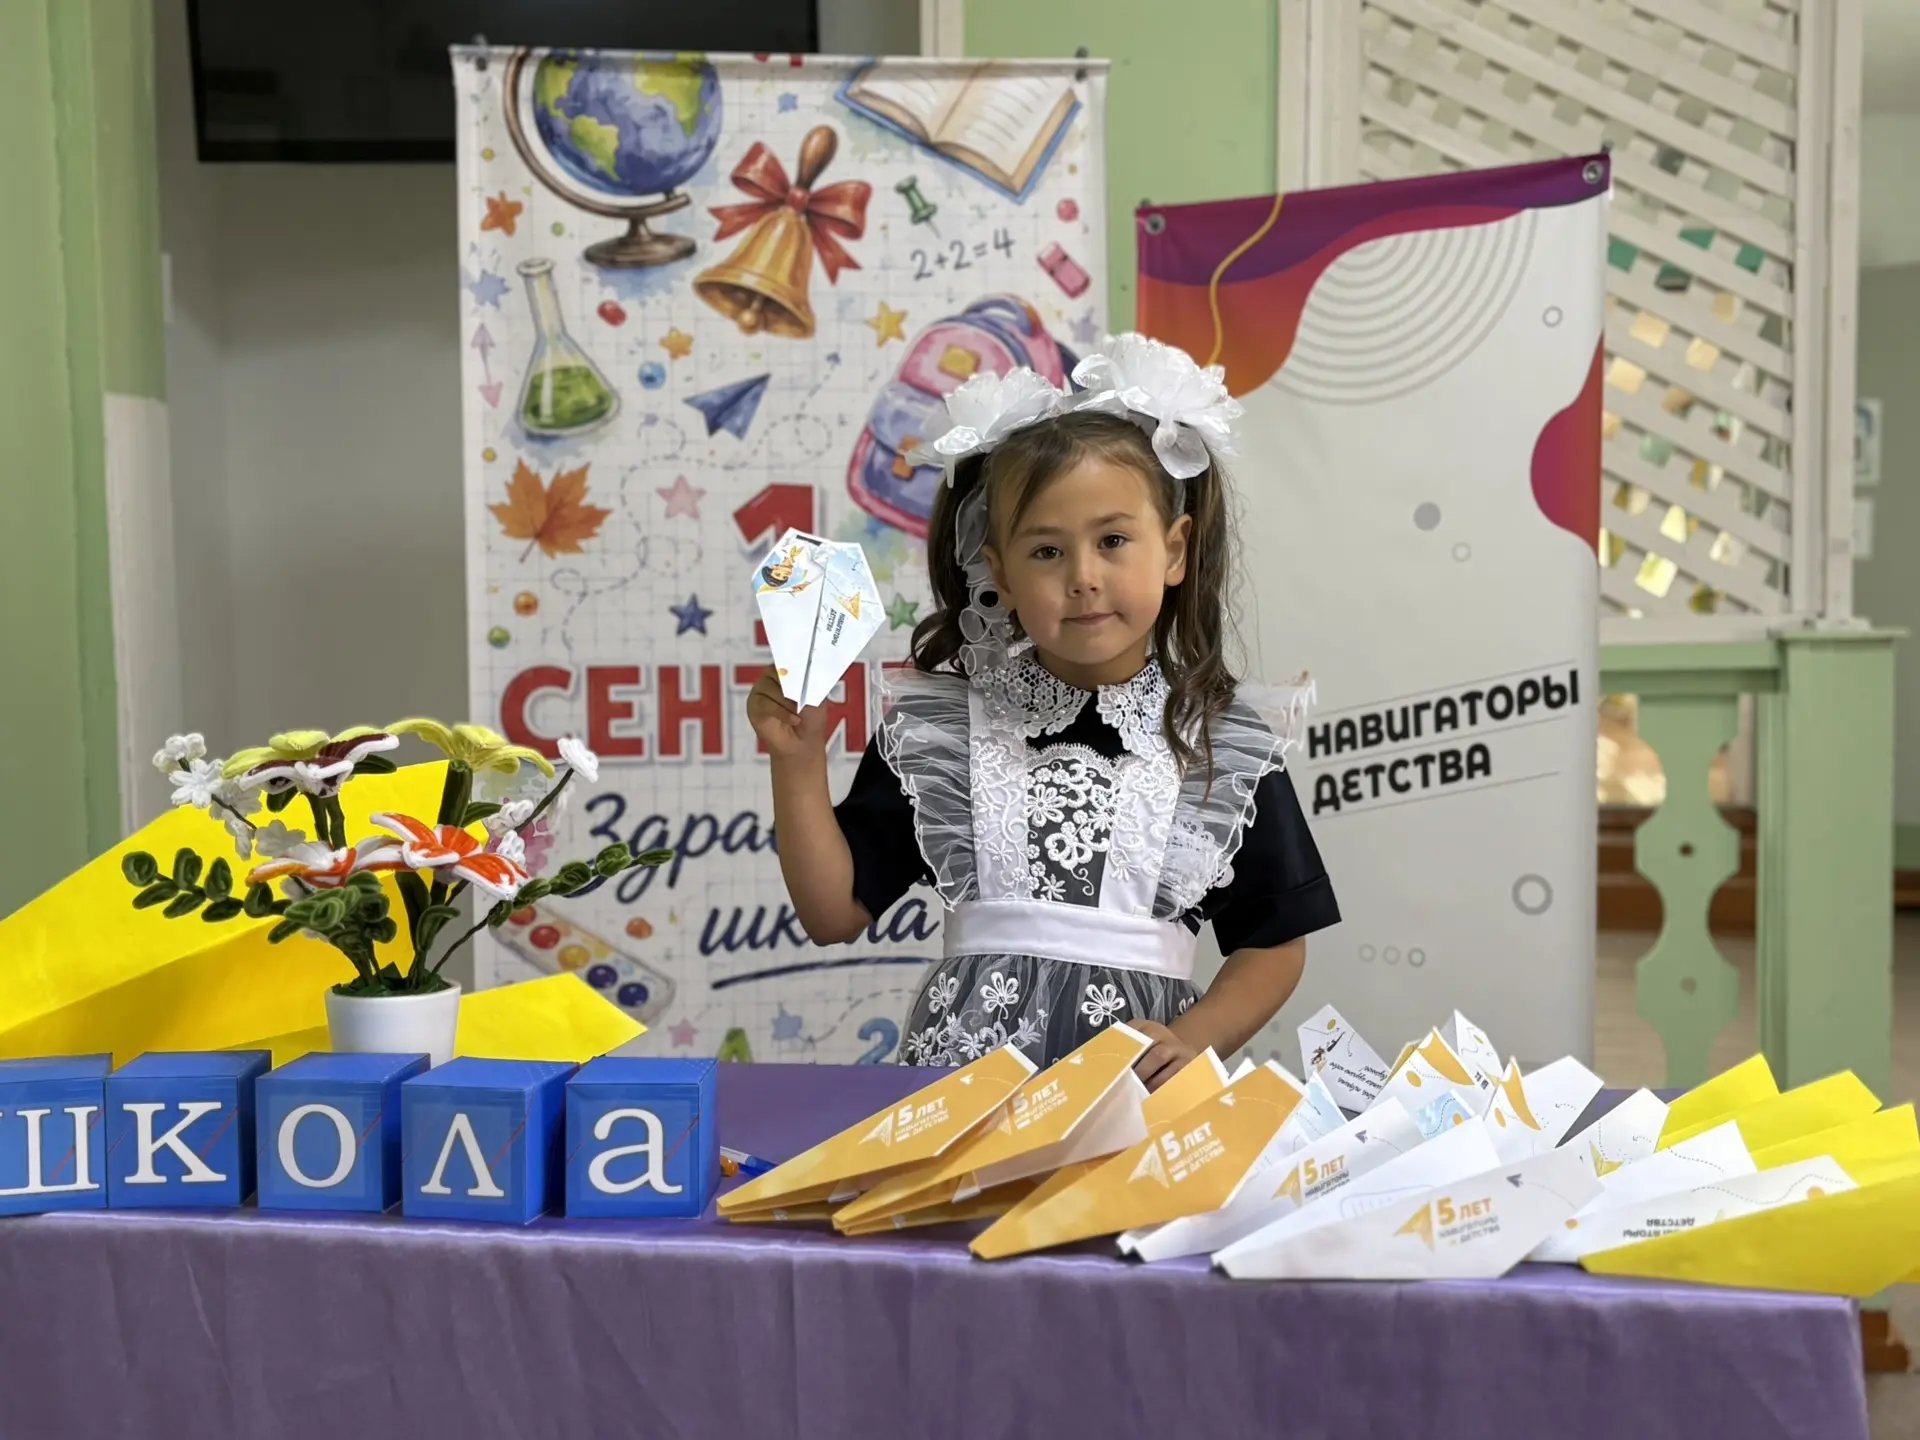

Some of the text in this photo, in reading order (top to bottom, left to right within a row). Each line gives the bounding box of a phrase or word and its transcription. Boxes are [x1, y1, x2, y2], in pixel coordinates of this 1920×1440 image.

[910, 227, 1017, 282] 2+2=4
[1308, 670, 1580, 759] НАВИГАТОРЫ
[1312, 743, 1491, 816] ДЕТСТВА
[898, 1096, 946, 1127] 5 ЛЕТ
[1160, 1121, 1212, 1162] 5 ЛЕТ
[1303, 1154, 1345, 1186] 5 ЛЕТ
[1437, 1196, 1491, 1226] 5 ЛЕТ
